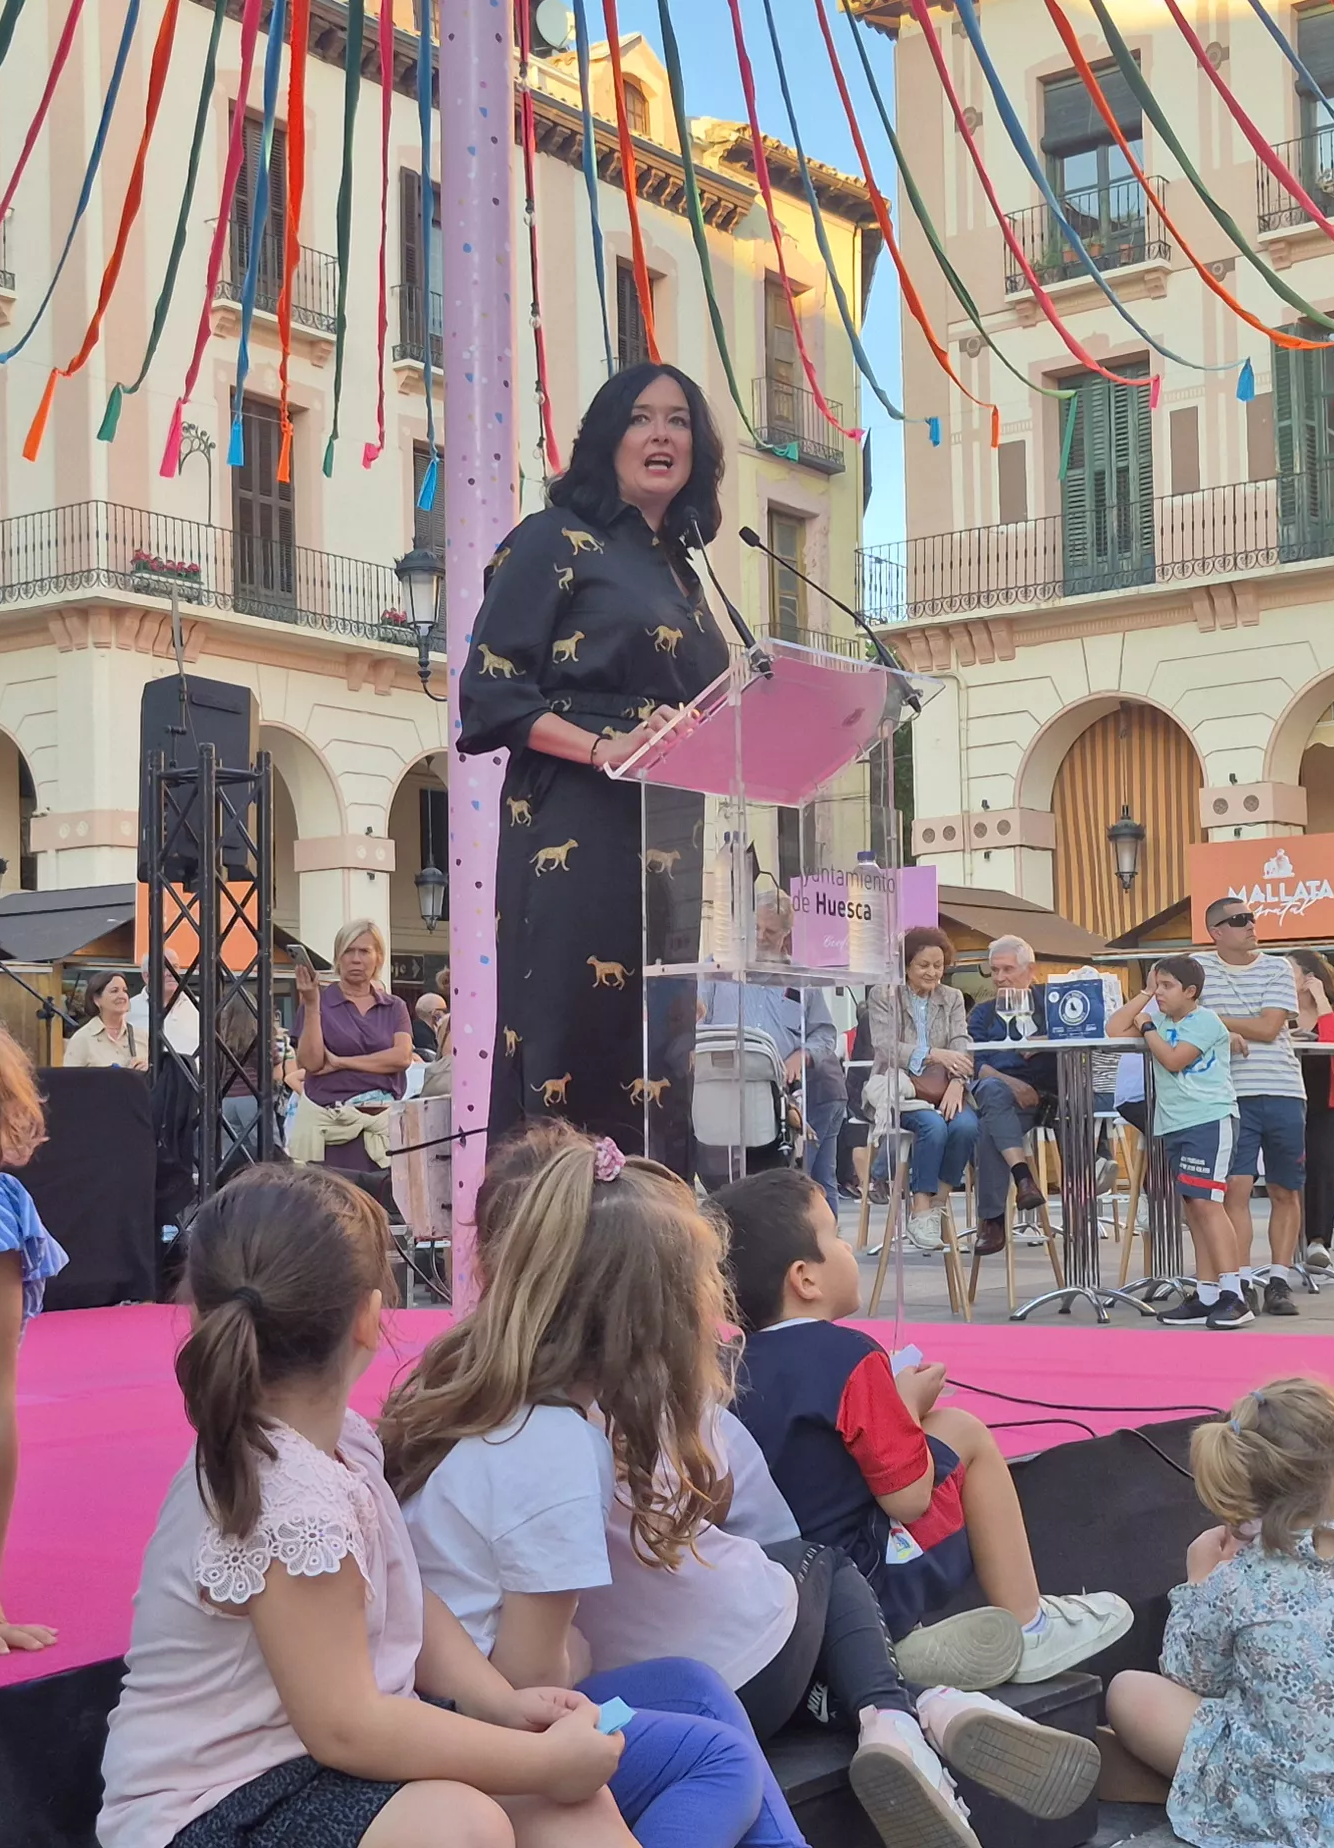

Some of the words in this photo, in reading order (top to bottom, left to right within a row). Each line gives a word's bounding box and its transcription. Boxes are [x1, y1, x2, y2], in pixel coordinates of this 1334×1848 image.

[801, 861, 896, 894] yuntamiento
[1228, 879, 1334, 905] MALLATA
[792, 892, 810, 913] de
[816, 892, 871, 921] Huesca
